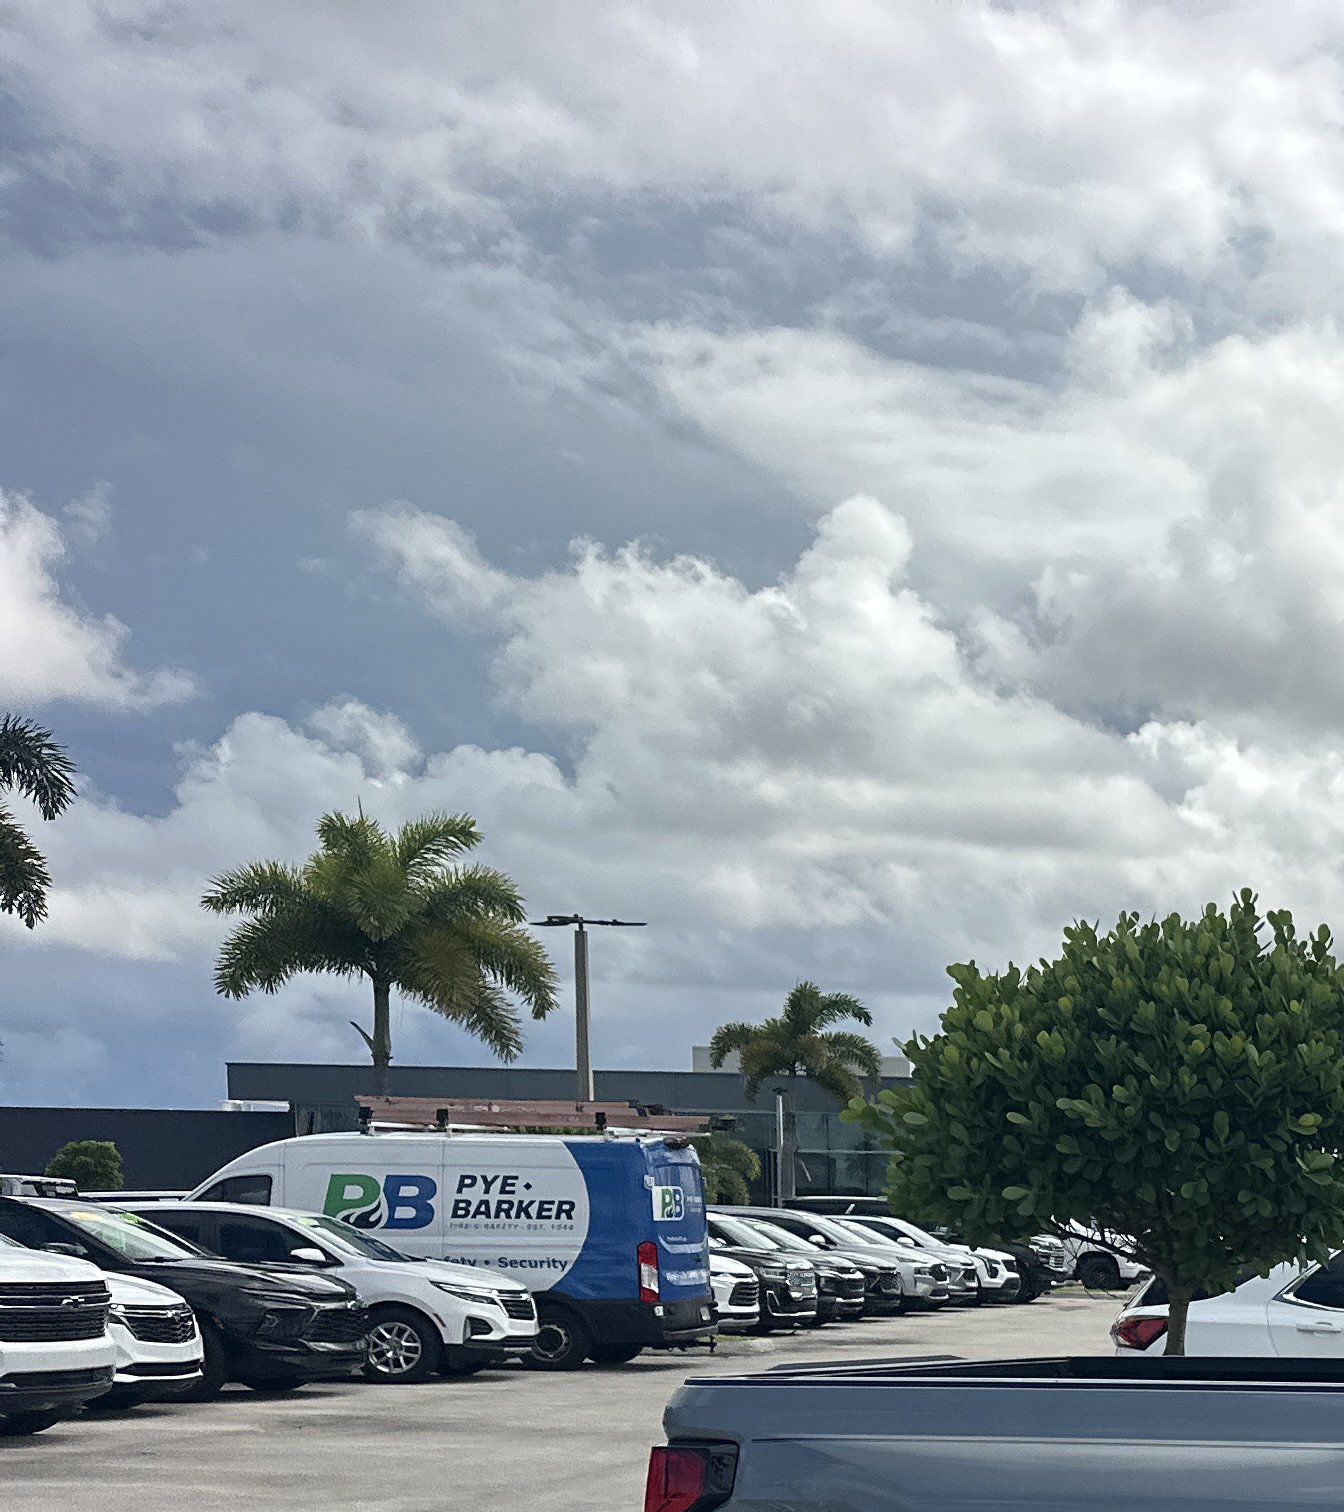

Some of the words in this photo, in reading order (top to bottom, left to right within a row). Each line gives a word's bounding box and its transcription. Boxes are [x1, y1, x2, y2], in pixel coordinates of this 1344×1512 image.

[456, 1174, 519, 1194] PYE
[451, 1199, 576, 1220] BARKER
[497, 1256, 568, 1272] Security
